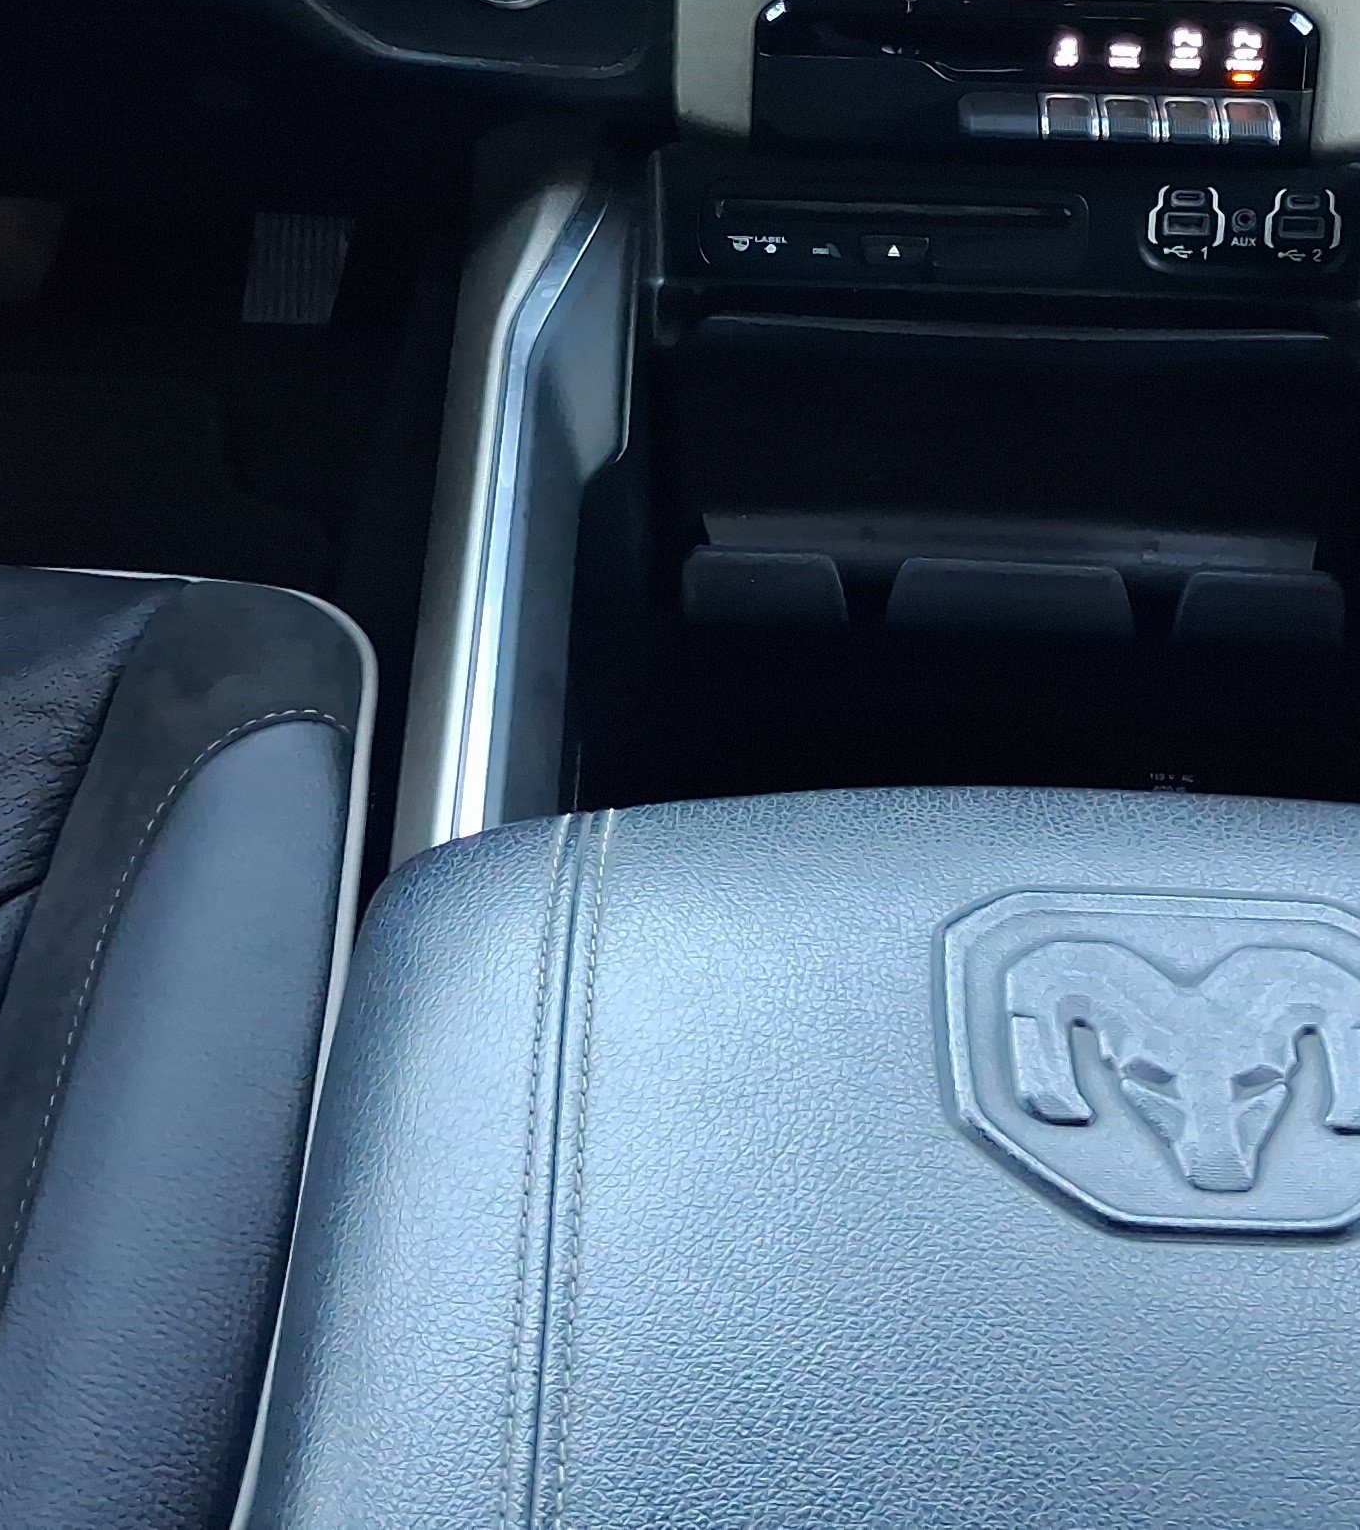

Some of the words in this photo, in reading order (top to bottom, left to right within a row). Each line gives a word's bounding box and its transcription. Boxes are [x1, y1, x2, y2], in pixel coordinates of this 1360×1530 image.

[754, 235, 788, 244] LABEL
[1230, 236, 1258, 247] AUX
[1200, 245, 1209, 261] 1
[1311, 248, 1323, 263] 2
